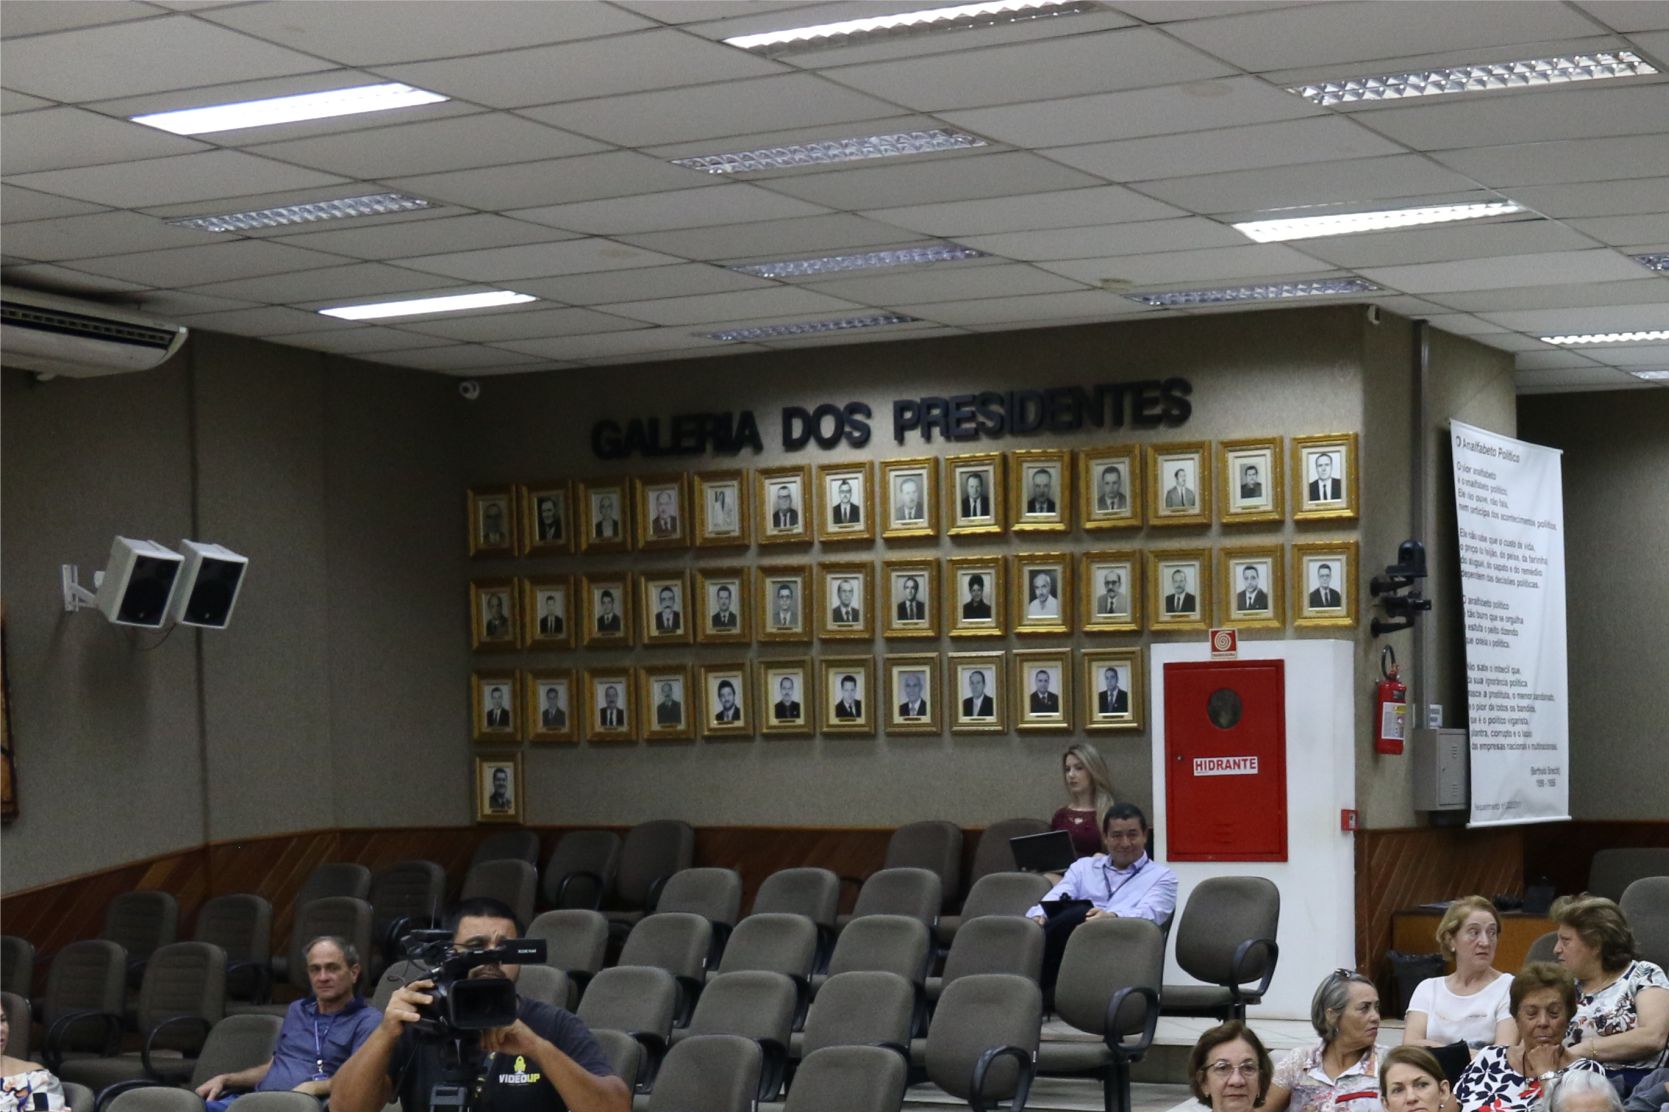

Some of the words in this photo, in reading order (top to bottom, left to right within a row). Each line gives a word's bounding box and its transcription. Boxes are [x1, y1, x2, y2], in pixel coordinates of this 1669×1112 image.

[592, 408, 763, 461] GALERIA
[781, 401, 872, 453] DOS
[892, 377, 1194, 447] PRESIDENTES
[1455, 435, 1462, 448] O
[1462, 439, 1497, 458] Analfabeto
[1195, 758, 1257, 772] HIDRANTE
[499, 1073, 540, 1084] VIDEOUP
